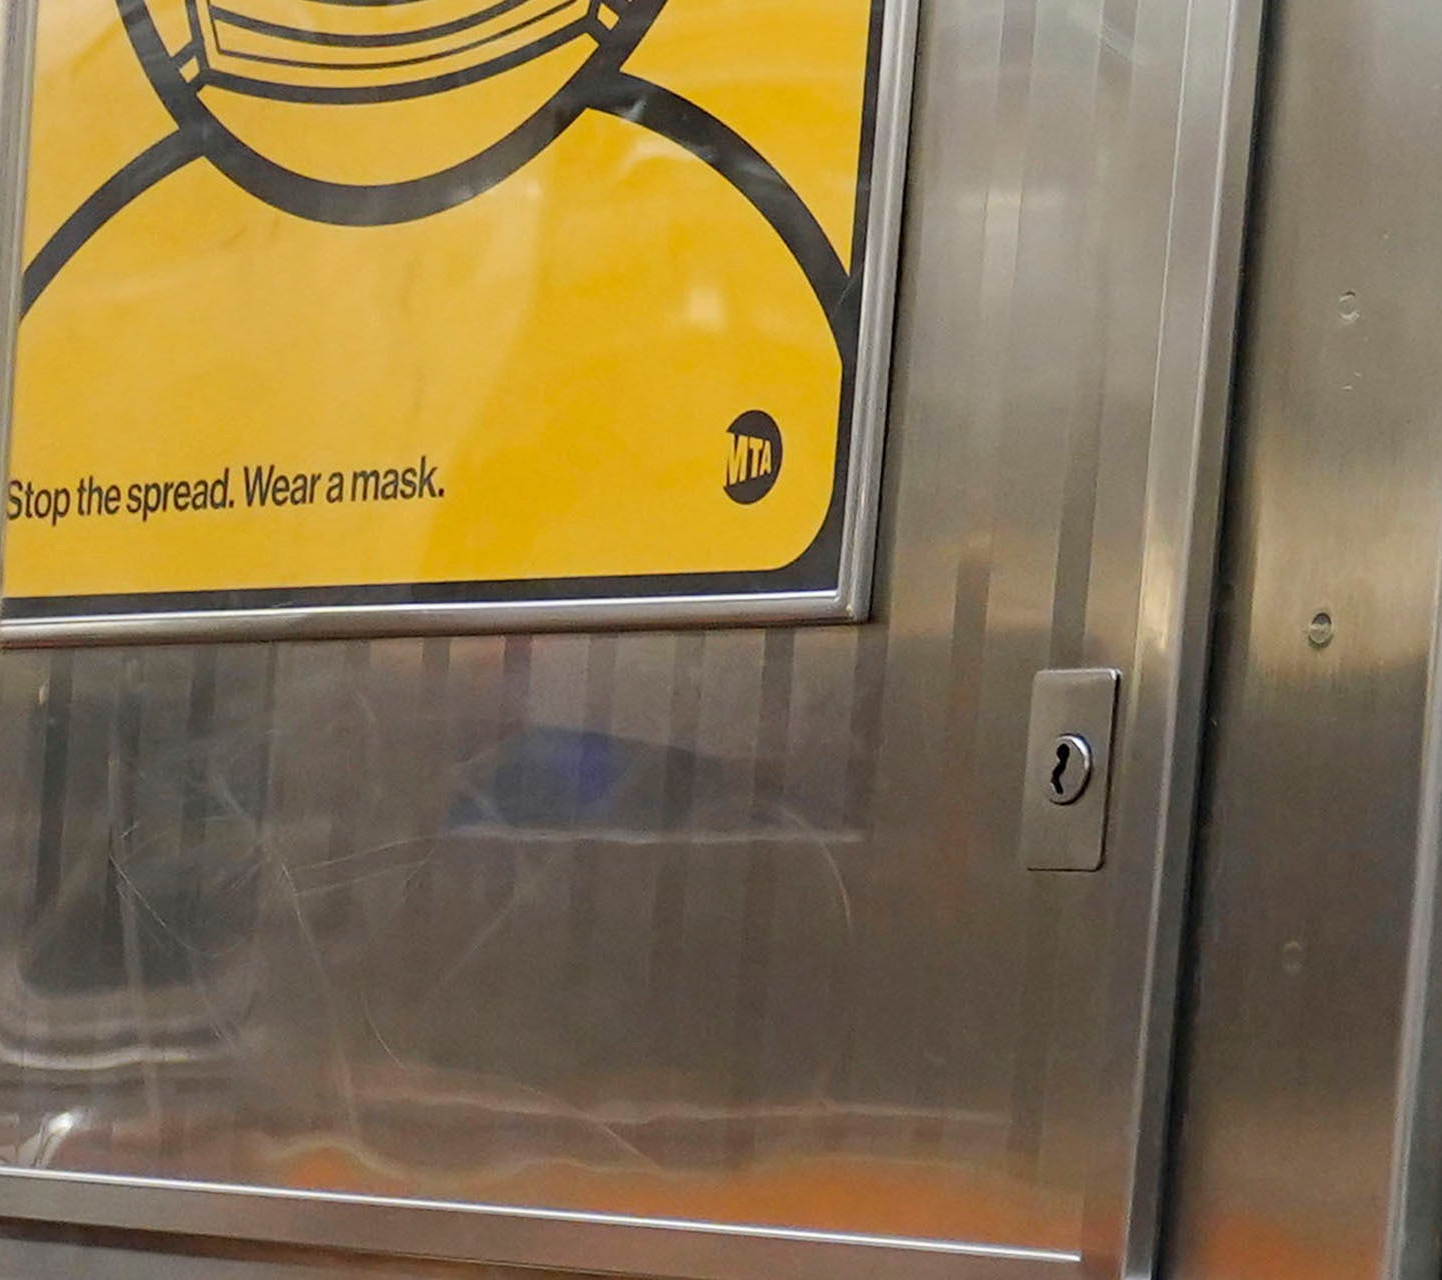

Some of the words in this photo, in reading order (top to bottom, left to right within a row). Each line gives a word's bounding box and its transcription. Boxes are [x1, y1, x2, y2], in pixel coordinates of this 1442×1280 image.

[6, 479, 71, 526] Stop
[76, 475, 122, 516] the
[125, 466, 235, 522] spread.
[243, 464, 322, 508] Wear
[325, 471, 345, 504] a
[351, 455, 445, 502] mask.
